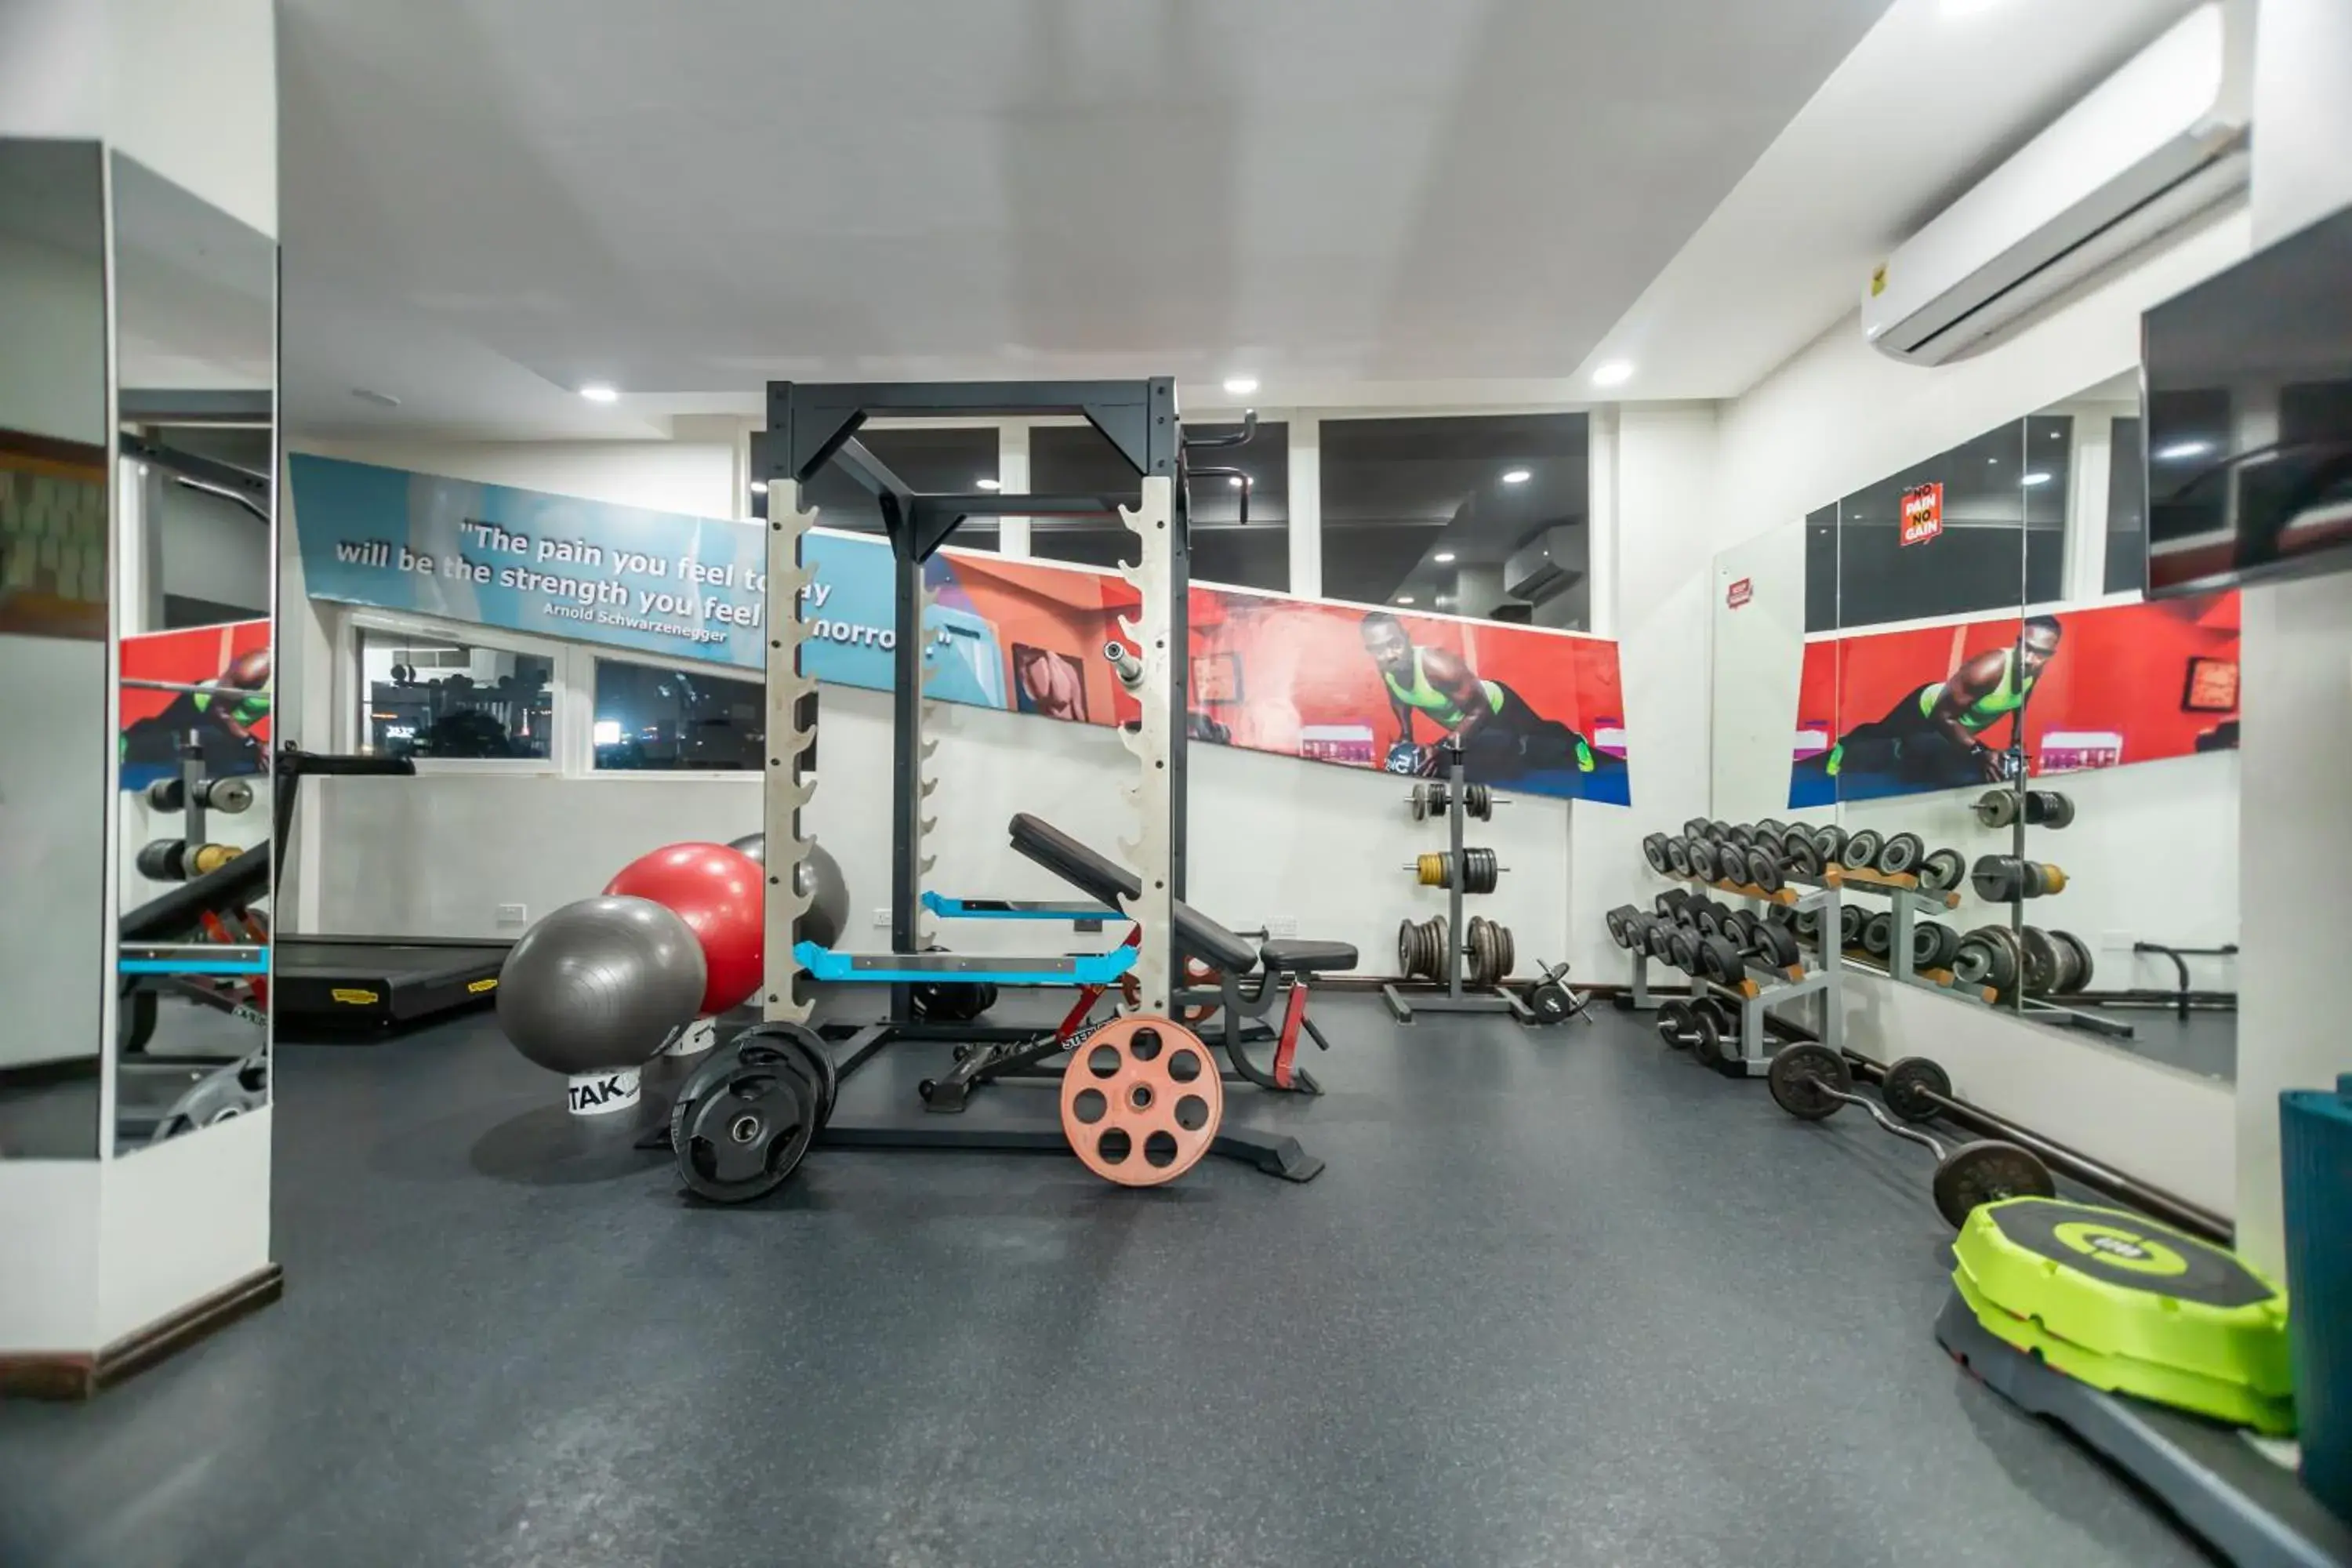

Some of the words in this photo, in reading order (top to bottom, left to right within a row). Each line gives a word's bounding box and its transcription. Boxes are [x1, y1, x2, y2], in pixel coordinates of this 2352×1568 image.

[1914, 485, 1932, 499] NO
[1906, 493, 1936, 517] PAIN
[1905, 519, 1938, 539] GAIN
[1913, 510, 1931, 525] NO
[460, 521, 528, 554] "The
[536, 538, 602, 566] pain
[612, 551, 667, 577] you
[677, 557, 734, 586] feel
[336, 541, 389, 568] will
[399, 550, 434, 575] be
[443, 556, 492, 583] the
[499, 568, 629, 606] strength
[640, 590, 692, 616] you
[705, 597, 760, 626] feel
[543, 603, 593, 621] Arnold
[597, 611, 728, 642] Schwarzenegger
